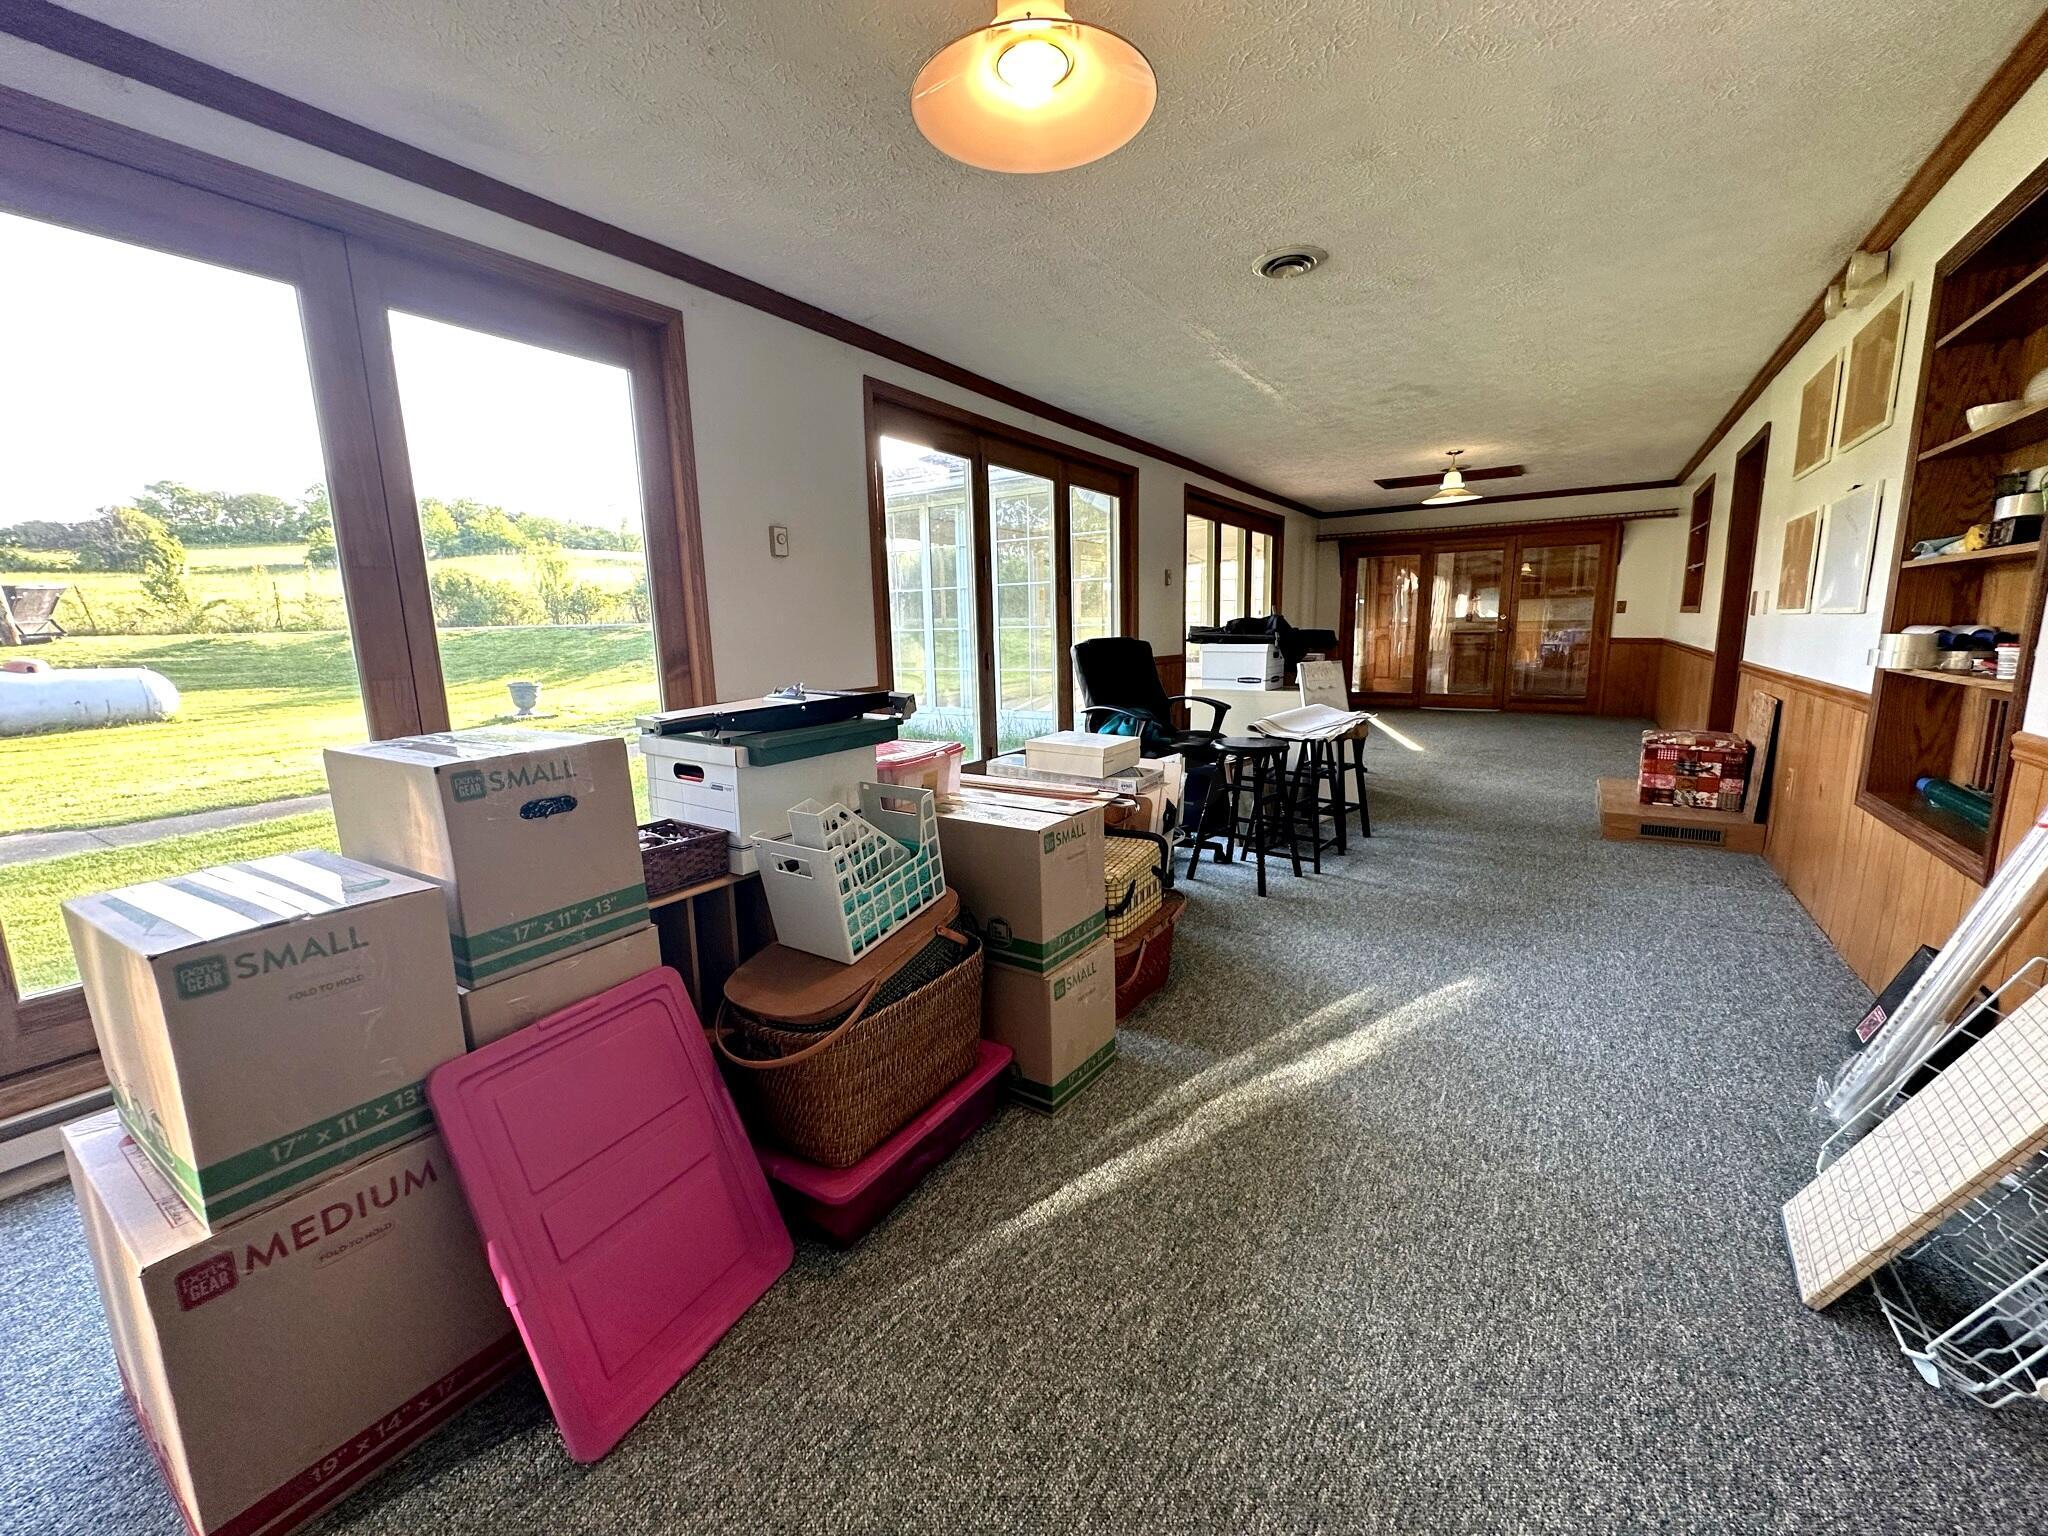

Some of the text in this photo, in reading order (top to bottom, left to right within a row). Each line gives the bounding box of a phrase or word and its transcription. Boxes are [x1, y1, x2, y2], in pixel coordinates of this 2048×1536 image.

[458, 782, 482, 797] GEAR
[489, 760, 577, 792] SMALL
[1055, 822, 1086, 847] SMALL
[511, 896, 617, 942] 17" x 11" x 13"
[234, 926, 369, 979] SMALL
[179, 961, 223, 984] pen+
[185, 972, 224, 993] GEAR
[288, 974, 365, 1001] FOLD TO HOLD
[1066, 962, 1097, 991] SMALL
[271, 1133, 307, 1162] 17"
[316, 1129, 332, 1145] x
[337, 1108, 368, 1135] 11"
[375, 1104, 390, 1120] x
[246, 1159, 438, 1272] MEDIUM
[190, 1271, 233, 1302] GEAR
[308, 1369, 465, 1482] 19" x 14" x 17"
